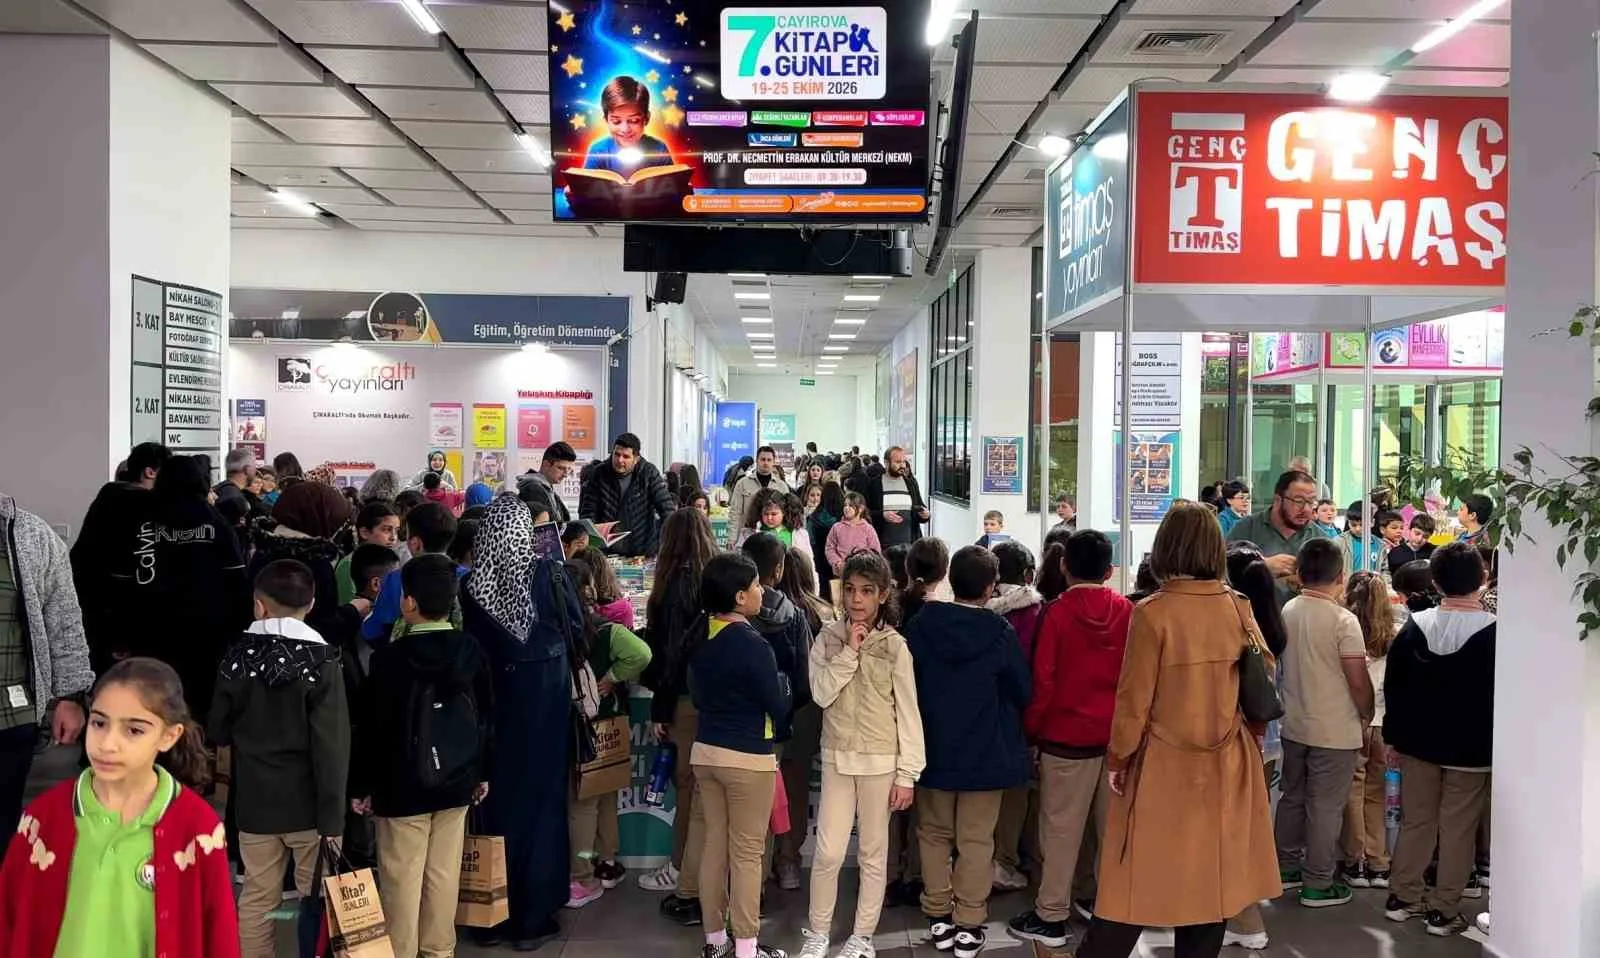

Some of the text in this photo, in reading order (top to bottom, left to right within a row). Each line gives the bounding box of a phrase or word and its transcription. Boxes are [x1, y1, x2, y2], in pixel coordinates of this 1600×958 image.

[752, 79, 858, 95] 19-25 EKİM 2026
[1167, 135, 1247, 160] GENÇ
[1267, 111, 1507, 190] GENÇ
[704, 152, 726, 163] PROF.
[728, 152, 740, 163] DR.
[742, 150, 784, 164] NECMETTİN
[821, 150, 850, 164] KÜLTÜR
[852, 150, 884, 163] MERKEZİ
[886, 152, 912, 165] (NEKM)
[1170, 230, 1239, 252] TİMAŞ
[1265, 197, 1507, 270] TİMAŞ
[170, 291, 192, 304] NİKAH
[136, 312, 160, 331] 3. KAT
[169, 312, 184, 322] BAY
[474, 322, 616, 338] Eğitim, Öğretim Döneminde
[329, 376, 404, 394] yayınları
[136, 398, 160, 414] 2. KAT
[168, 392, 192, 404] NİKAH
[168, 414, 192, 424] BAYAN
[168, 434, 182, 443] WC
[134, 521, 156, 584] Calvin
